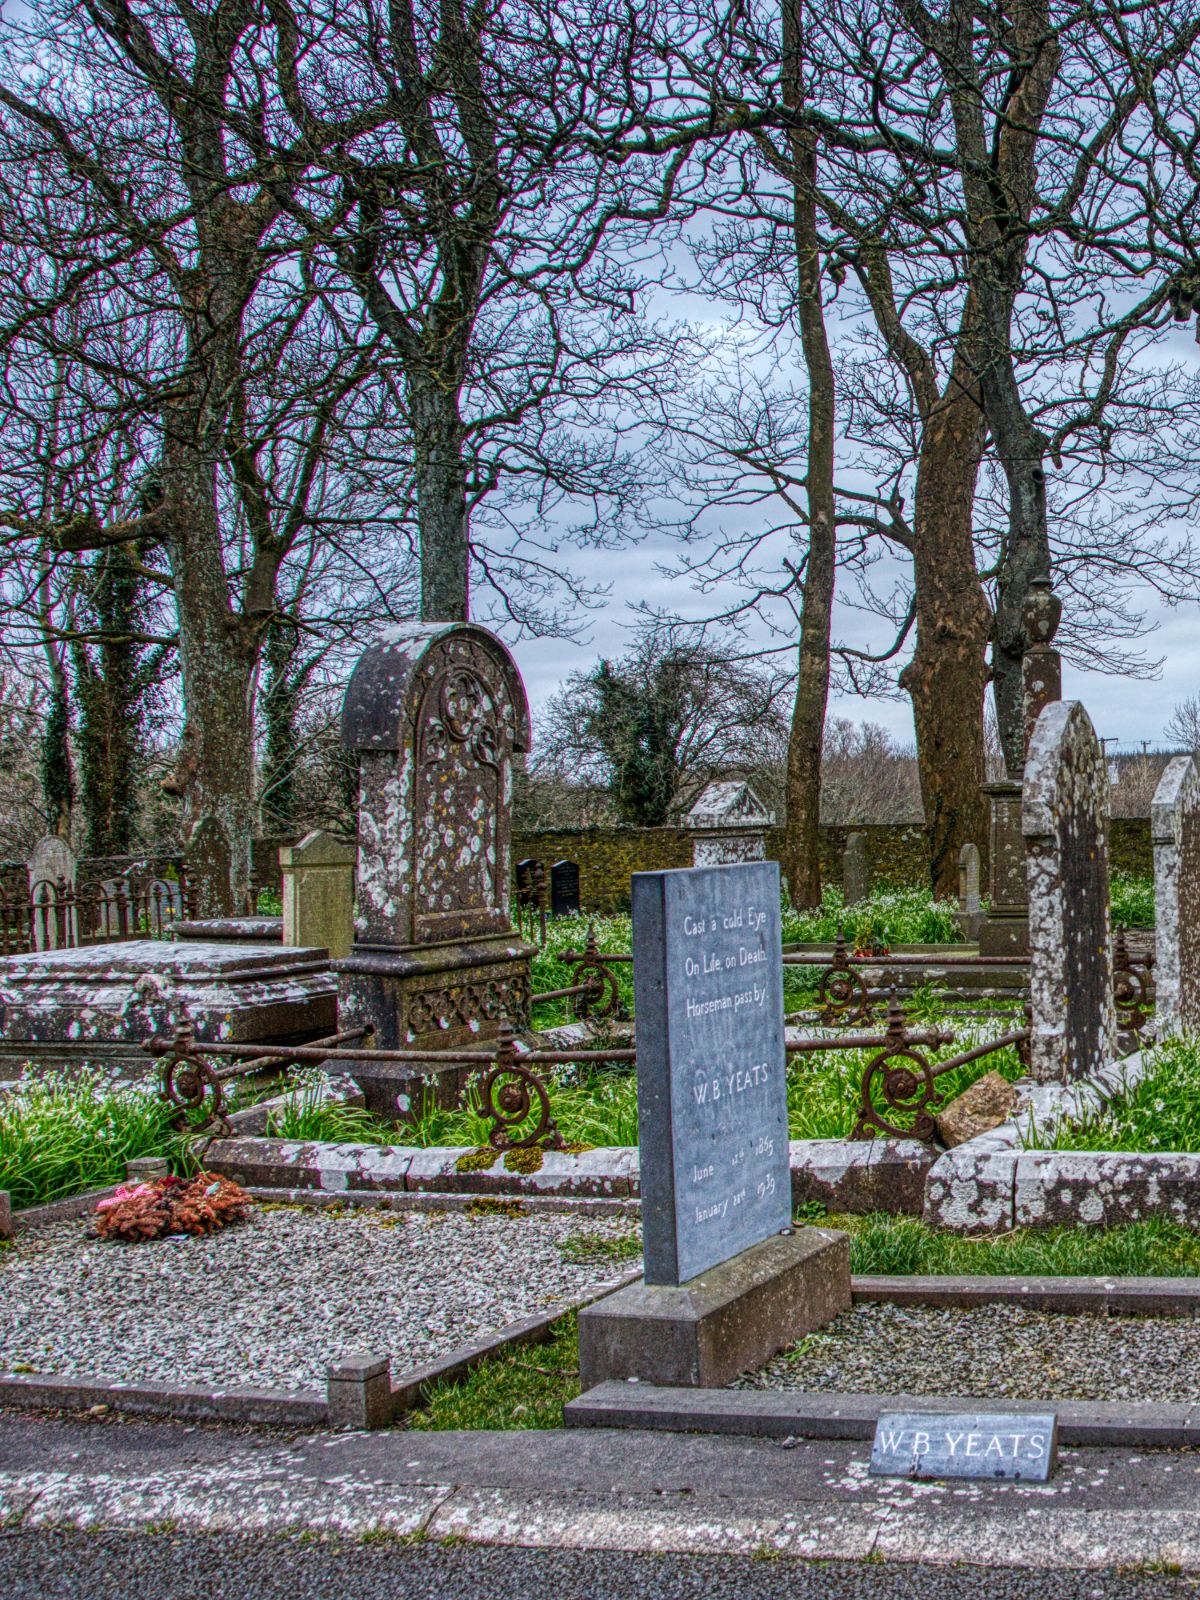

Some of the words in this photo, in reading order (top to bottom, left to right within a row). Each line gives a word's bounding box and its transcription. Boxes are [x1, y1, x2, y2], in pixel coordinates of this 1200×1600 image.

[684, 915, 706, 936] Cast
[711, 919, 716, 931] a
[723, 908, 743, 929] cold
[748, 906, 767, 932] Eye
[685, 957, 699, 976] On
[725, 955, 737, 969] on
[734, 991, 753, 1013] pass
[693, 1164, 715, 1183] June
[755, 1135, 774, 1157] 1865
[694, 1198, 729, 1225] January
[756, 1173, 776, 1201] 1939
[880, 1431, 905, 1455] W
[913, 1431, 930, 1455] B
[945, 1432, 1046, 1459] YEATS
